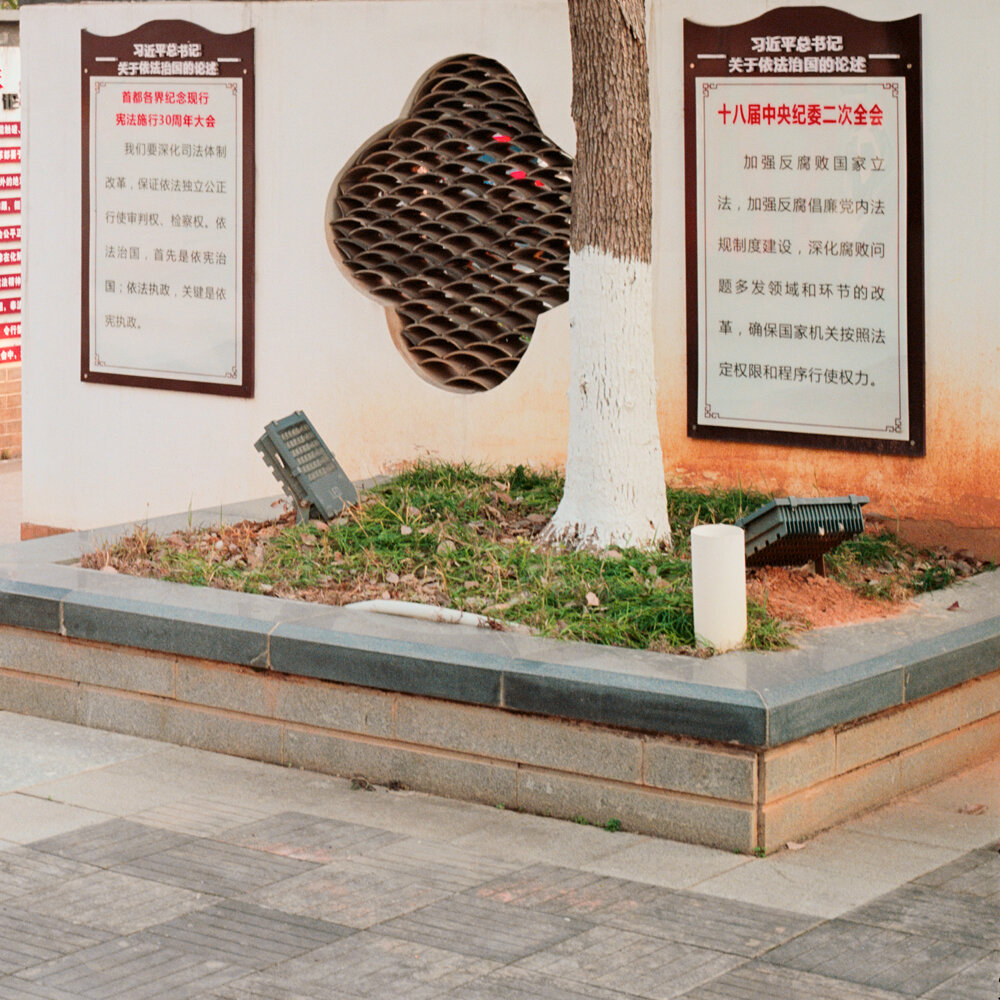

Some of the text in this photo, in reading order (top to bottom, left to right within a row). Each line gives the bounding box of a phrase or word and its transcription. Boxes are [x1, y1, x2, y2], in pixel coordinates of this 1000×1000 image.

[133, 43, 202, 58] 习近平总书记
[751, 35, 844, 52] 习近平总书记
[117, 61, 219, 76] 关于依法治国的论述
[728, 56, 867, 73] 关于依法治国的论述
[121, 91, 209, 105] 首都各界纪念现行
[115, 113, 216, 128] 宪法施行30周年大会
[717, 103, 884, 126] 十八届中央纪委二次全会
[124, 142, 227, 159] 我们要深化司法体制
[743, 154, 885, 172] 加强反腐败国家立
[717, 195, 885, 215] 法，加强反腐倡廉党内法
[717, 236, 885, 259] 规制度建设，深化腐败问
[718, 278, 886, 301] 题多发领域和环节的改
[104, 314, 141, 330] 宪执政。
[718, 319, 886, 345] 革，确保国家机关按照法
[718, 361, 876, 387] 定权限和程序行使权力。
